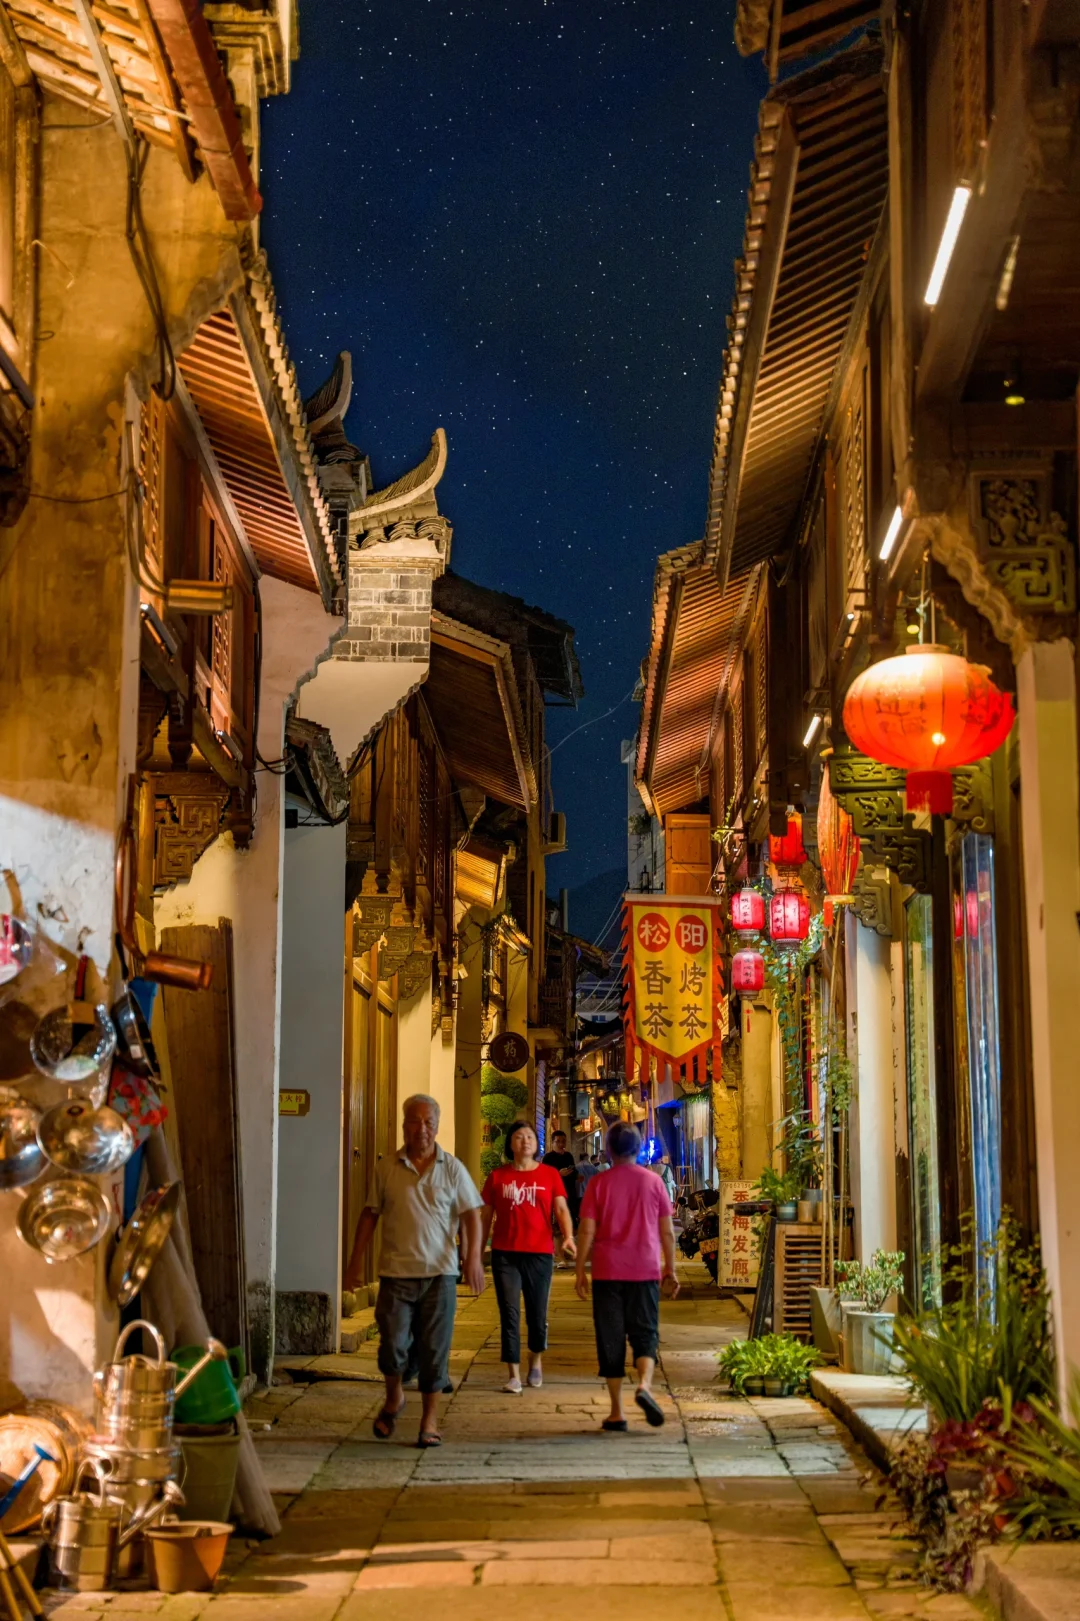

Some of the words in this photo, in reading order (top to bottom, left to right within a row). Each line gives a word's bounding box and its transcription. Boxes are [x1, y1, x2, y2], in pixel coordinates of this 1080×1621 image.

[640, 919, 705, 948] 松阳
[640, 960, 673, 1039] 香茶
[678, 961, 707, 1040] 烤茶
[280, 1094, 303, 1103] 火栓
